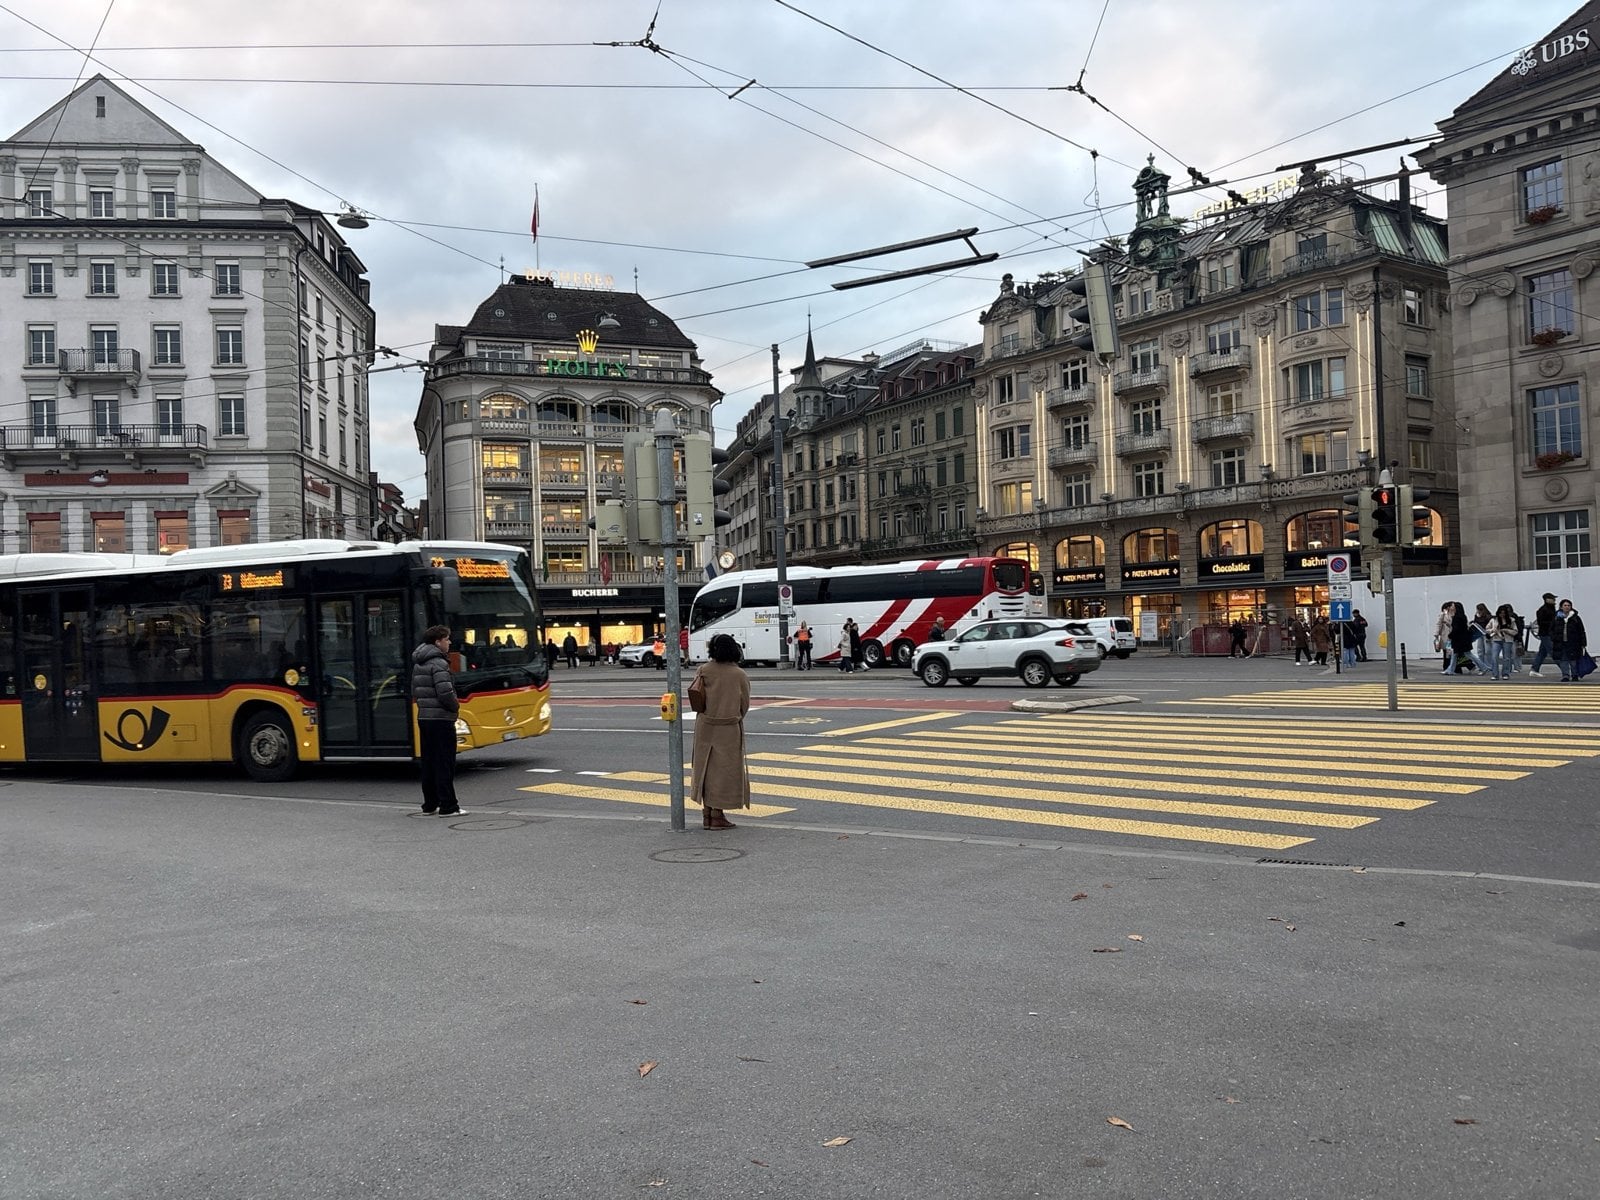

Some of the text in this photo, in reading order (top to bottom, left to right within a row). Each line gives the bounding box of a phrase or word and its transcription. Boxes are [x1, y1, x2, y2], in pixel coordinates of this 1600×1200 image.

[1541, 28, 1590, 62] UBS
[524, 267, 614, 286] BUCHERER
[547, 359, 629, 377] ROLEX
[1302, 556, 1328, 567] Bachm
[1132, 568, 1170, 578] PATEK PHILIPPE
[1212, 562, 1251, 574] Chocolatier
[572, 589, 618, 597] BUCHERER
